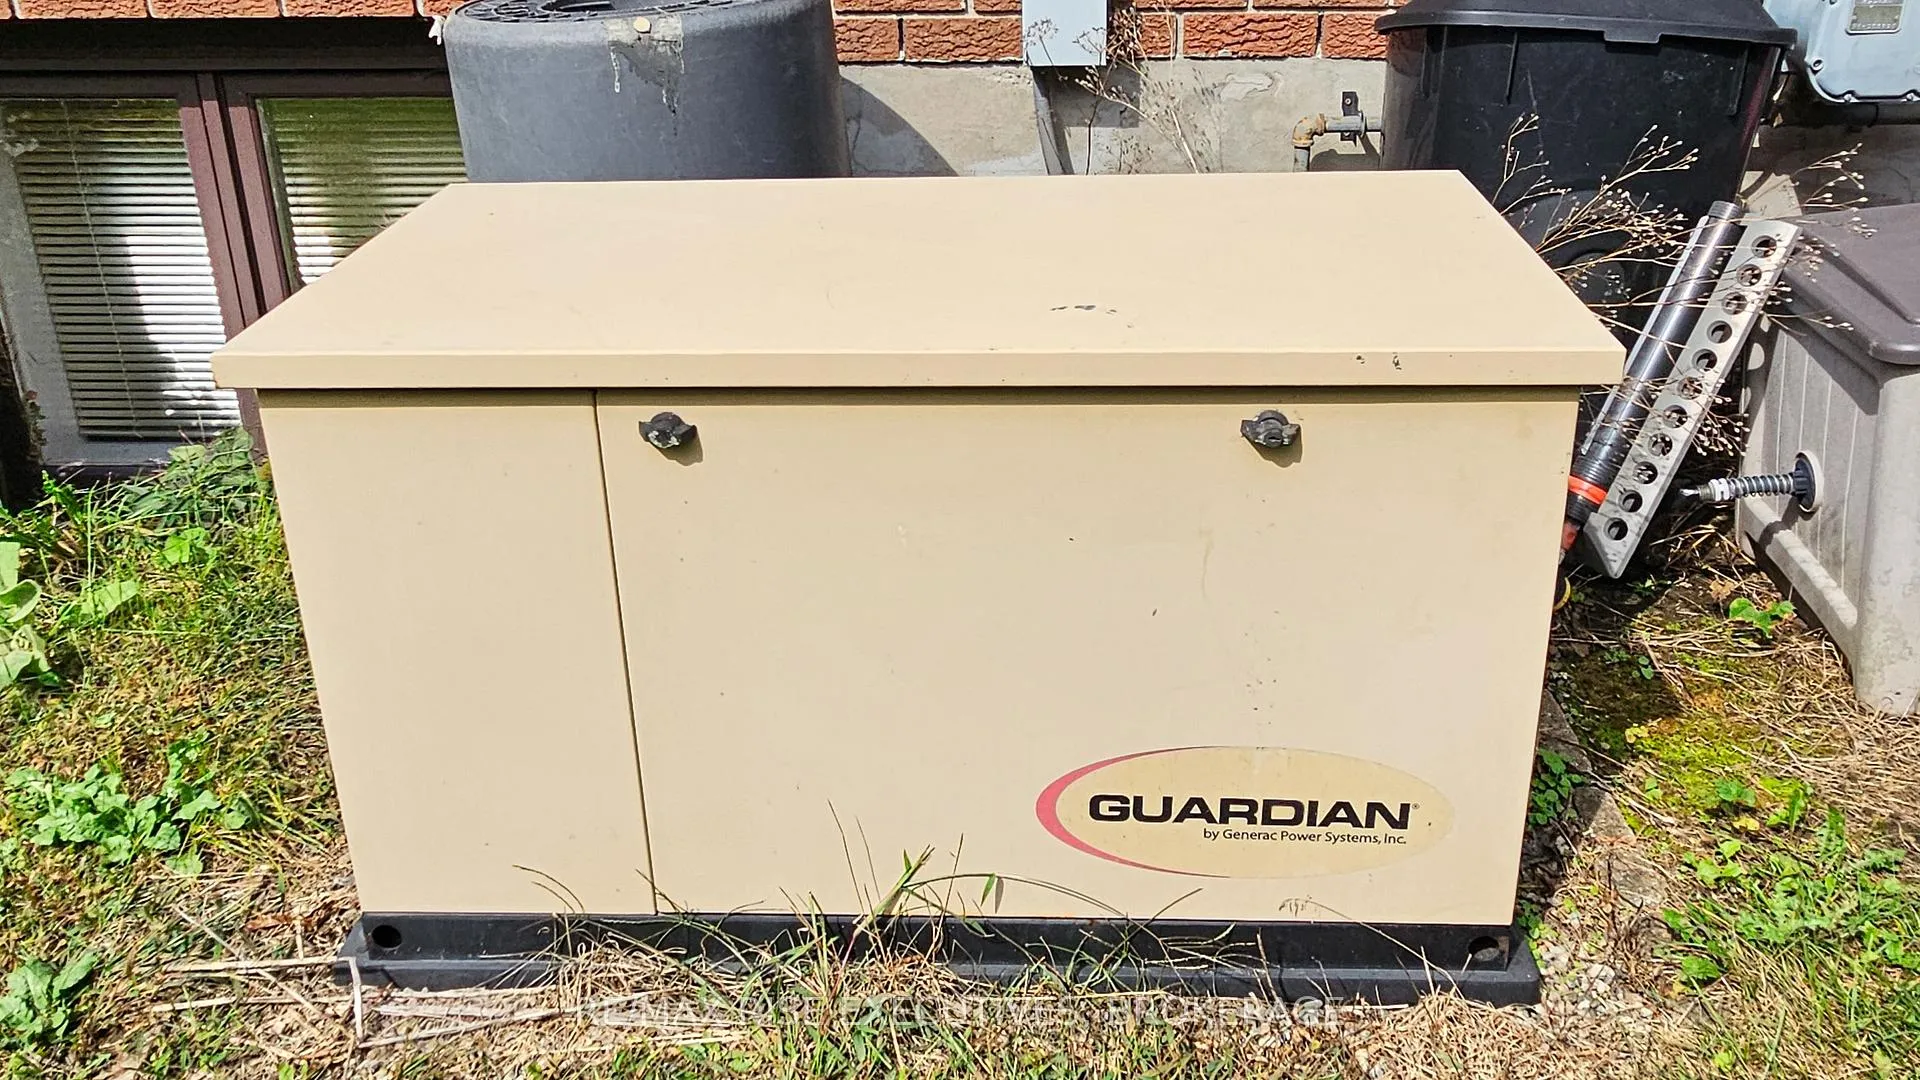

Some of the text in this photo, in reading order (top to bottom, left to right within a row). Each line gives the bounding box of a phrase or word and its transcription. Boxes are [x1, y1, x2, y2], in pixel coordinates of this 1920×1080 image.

[1089, 794, 1411, 830] GUARDIAN
[1203, 828, 1407, 845] by Generac Power Systems, Inc.
